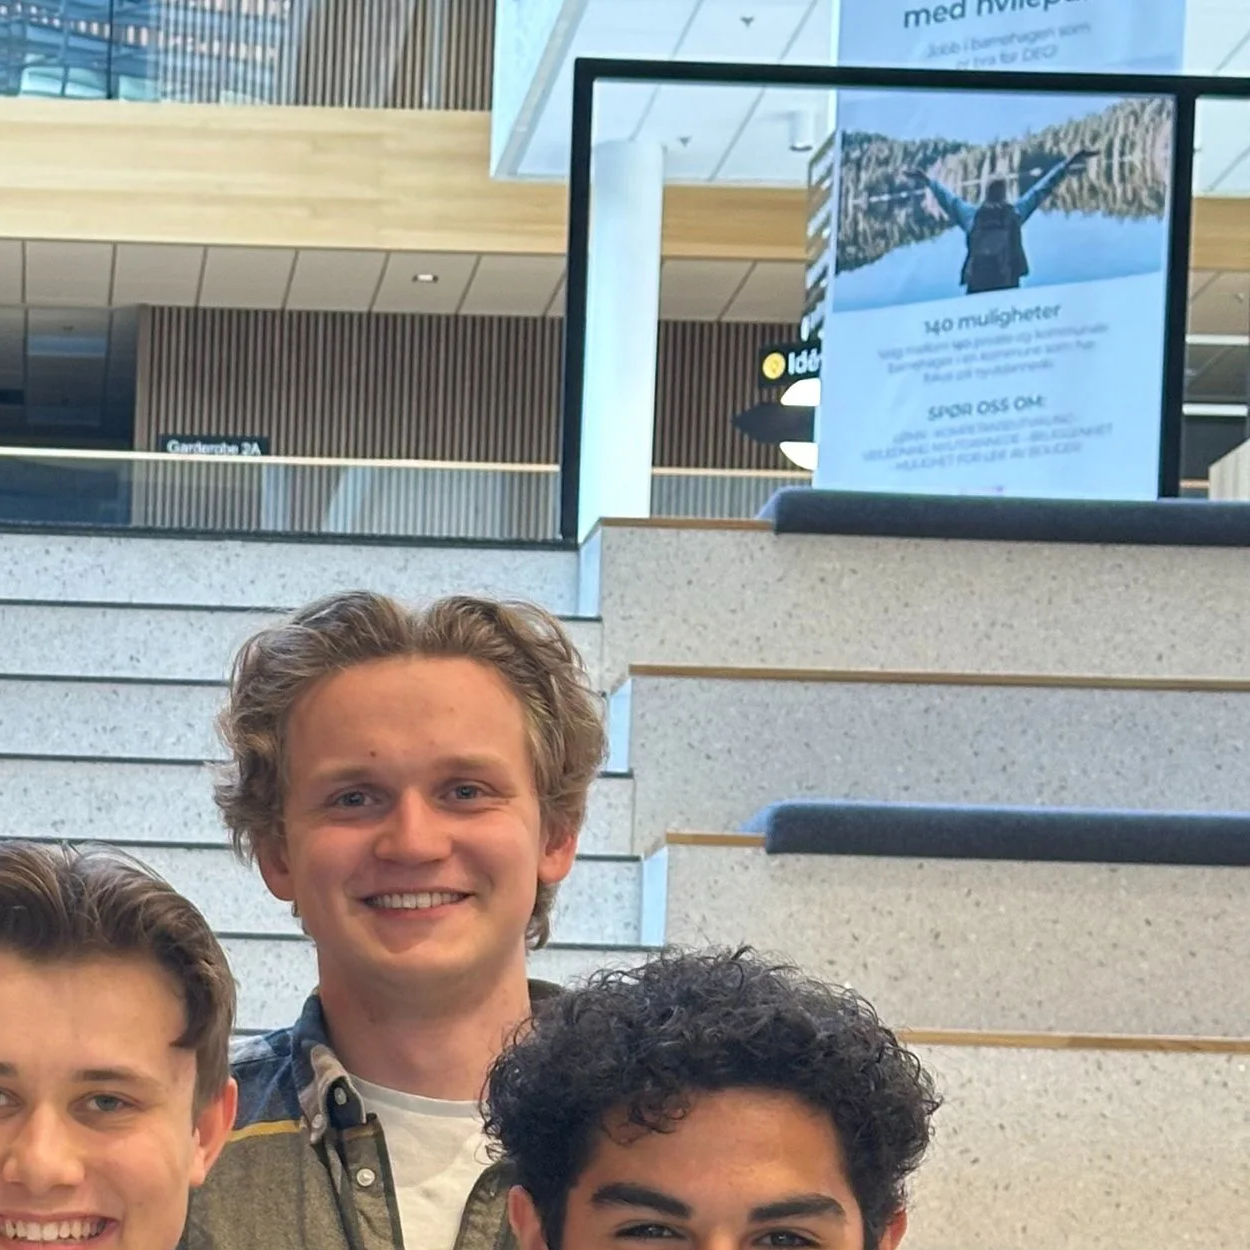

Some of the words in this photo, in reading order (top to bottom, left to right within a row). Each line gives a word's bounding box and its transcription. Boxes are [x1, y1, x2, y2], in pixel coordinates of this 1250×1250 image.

[903, 0, 966, 28] med
[924, 318, 954, 336] 140
[958, 304, 1061, 329] muligheter
[927, 403, 973, 421] SPØR
[977, 400, 1009, 415] OSS
[166, 439, 239, 455] Garderobe
